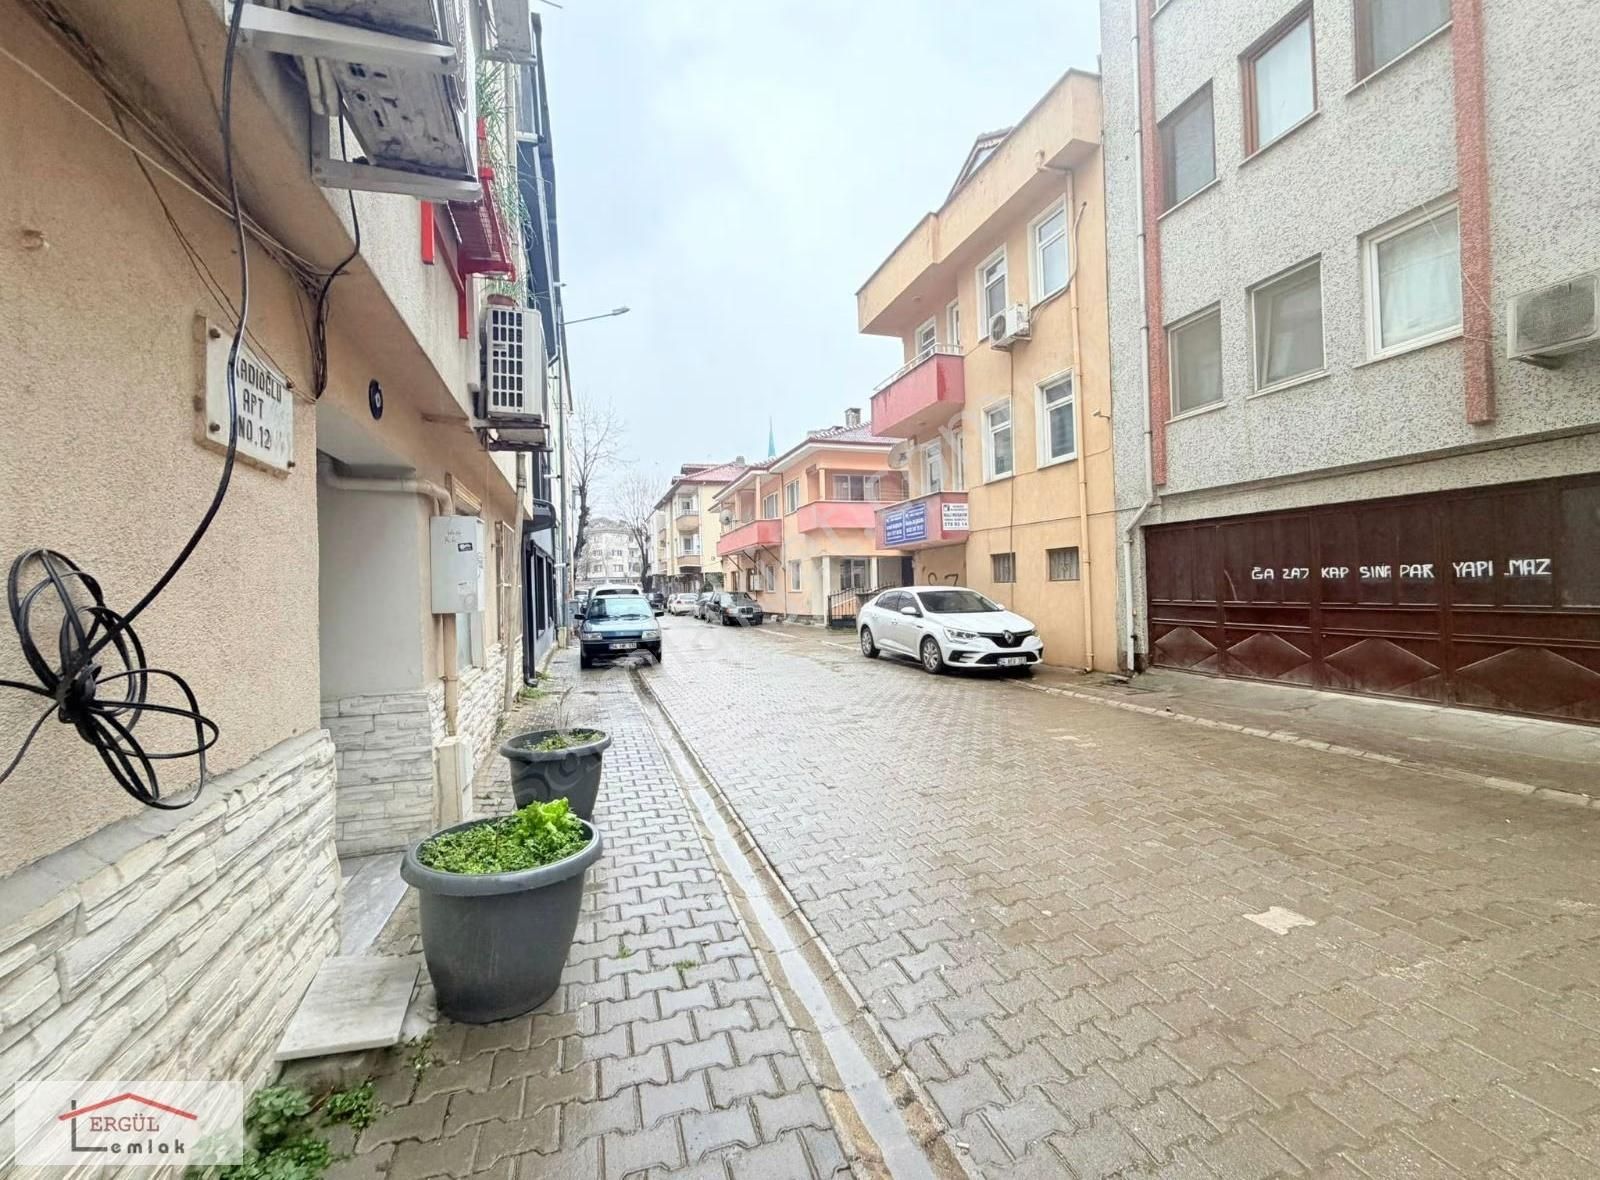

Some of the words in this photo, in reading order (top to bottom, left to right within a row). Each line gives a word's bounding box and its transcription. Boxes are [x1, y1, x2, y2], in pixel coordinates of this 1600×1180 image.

[243, 388, 264, 420] APT
[1320, 566, 1350, 579] KAP
[1452, 560, 1494, 578] YAPI
